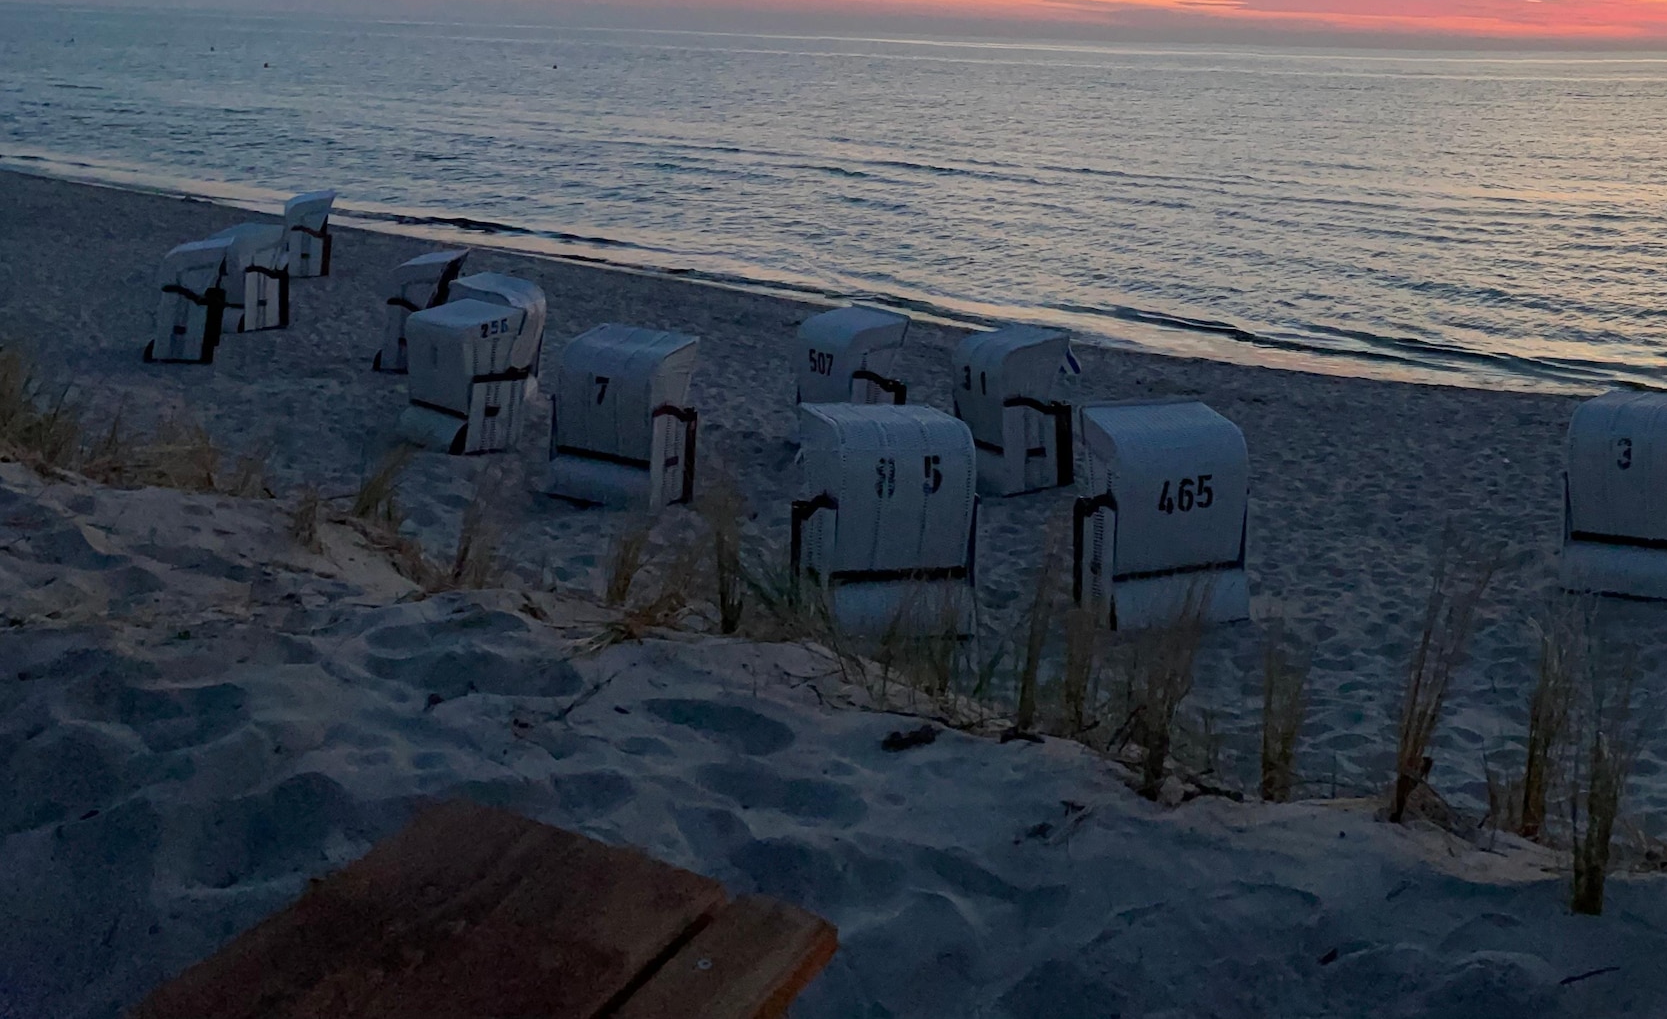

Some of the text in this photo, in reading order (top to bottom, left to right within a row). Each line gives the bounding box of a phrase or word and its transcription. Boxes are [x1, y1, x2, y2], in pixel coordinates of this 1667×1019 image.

[808, 348, 834, 376] 507
[594, 375, 610, 406] 7
[1617, 438, 1633, 471] 3
[1157, 474, 1213, 515] 465
